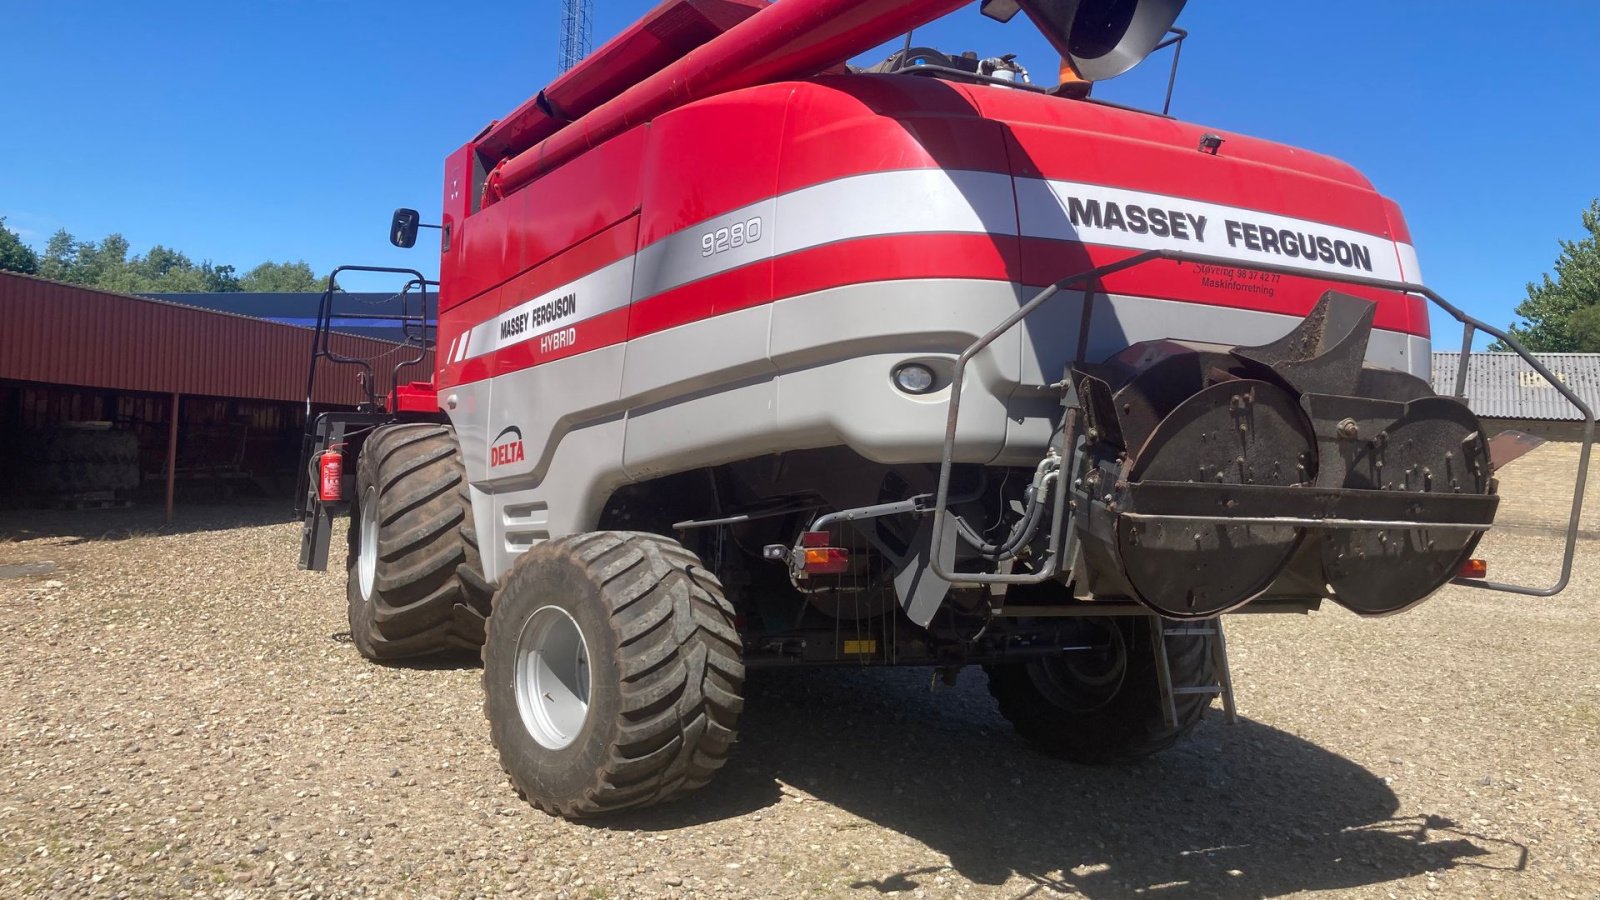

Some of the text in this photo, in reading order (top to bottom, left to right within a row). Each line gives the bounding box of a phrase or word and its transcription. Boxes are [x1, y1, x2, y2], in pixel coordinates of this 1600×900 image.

[702, 216, 762, 257] 9280
[1067, 196, 1373, 272] MASSEY FERGUSON
[1201, 277, 1274, 297] Maskinforretning
[1237, 268, 1247, 279] 98
[500, 293, 576, 340] MASSEY FERGUSON
[540, 327, 576, 354] HYBRID
[491, 440, 525, 467] DELTA
